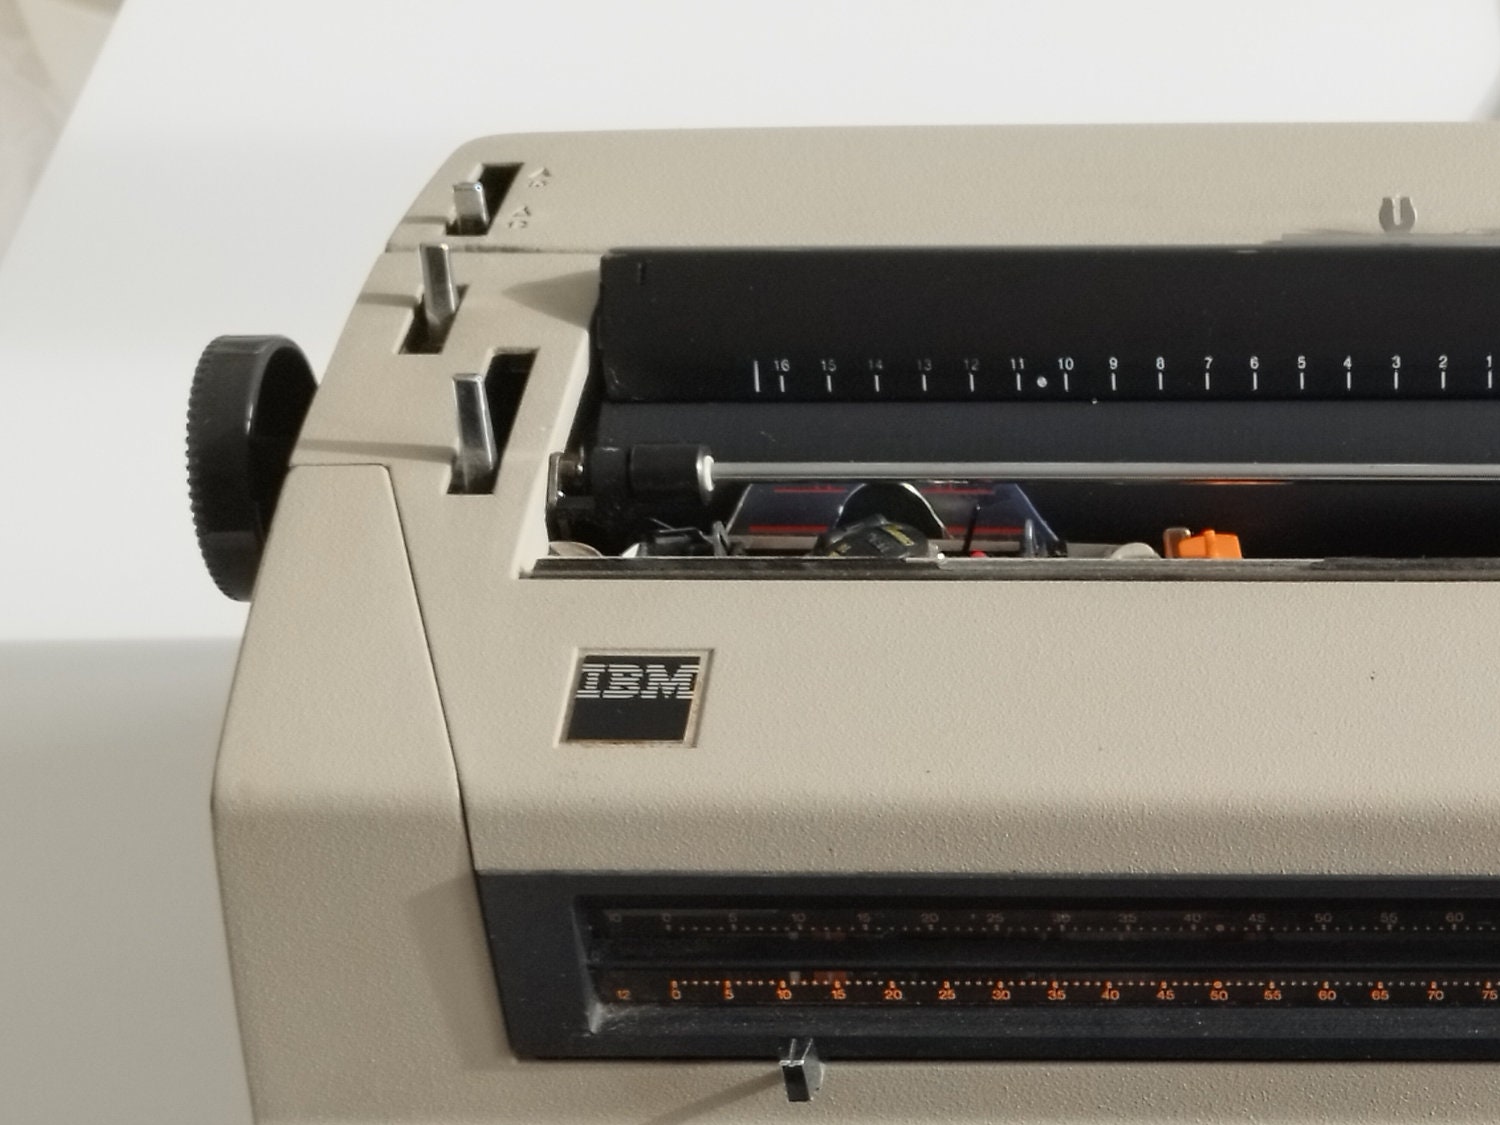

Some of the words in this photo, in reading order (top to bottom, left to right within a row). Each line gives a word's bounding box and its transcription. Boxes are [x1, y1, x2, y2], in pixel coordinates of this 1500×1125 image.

[774, 358, 790, 371] 16
[821, 359, 837, 371] 15
[868, 359, 884, 371] 14
[917, 358, 933, 371] 13
[964, 358, 979, 370] 12
[1010, 357, 1025, 369] 11
[1058, 357, 1074, 370] 10
[1108, 356, 1118, 369] 9
[1155, 356, 1165, 369] 8
[1204, 356, 1213, 369] 7
[1249, 356, 1260, 369] 6
[1297, 355, 1307, 368] 5
[1343, 355, 1352, 369] 4
[1391, 355, 1401, 368] 3
[1438, 354, 1448, 368] 2
[1486, 355, 1492, 367] 1
[575, 663, 700, 699] IBM
[615, 988, 631, 1001] 12
[670, 988, 682, 1000] 0
[723, 988, 735, 1000] 5
[775, 988, 793, 1000] 10
[830, 988, 847, 1000] 15
[883, 988, 903, 1001] 20
[938, 988, 956, 1001] 25
[991, 988, 1011, 1001] 30
[1047, 988, 1067, 1001] 35
[1101, 988, 1120, 1001] 40
[1156, 988, 1176, 1001] 45
[1209, 989, 1229, 1001] 50
[1263, 989, 1282, 1001] 55
[1317, 989, 1337, 1001] 60
[1370, 989, 1390, 1001] 65
[1426, 989, 1445, 1001] 70
[1481, 989, 1499, 1001] 75
